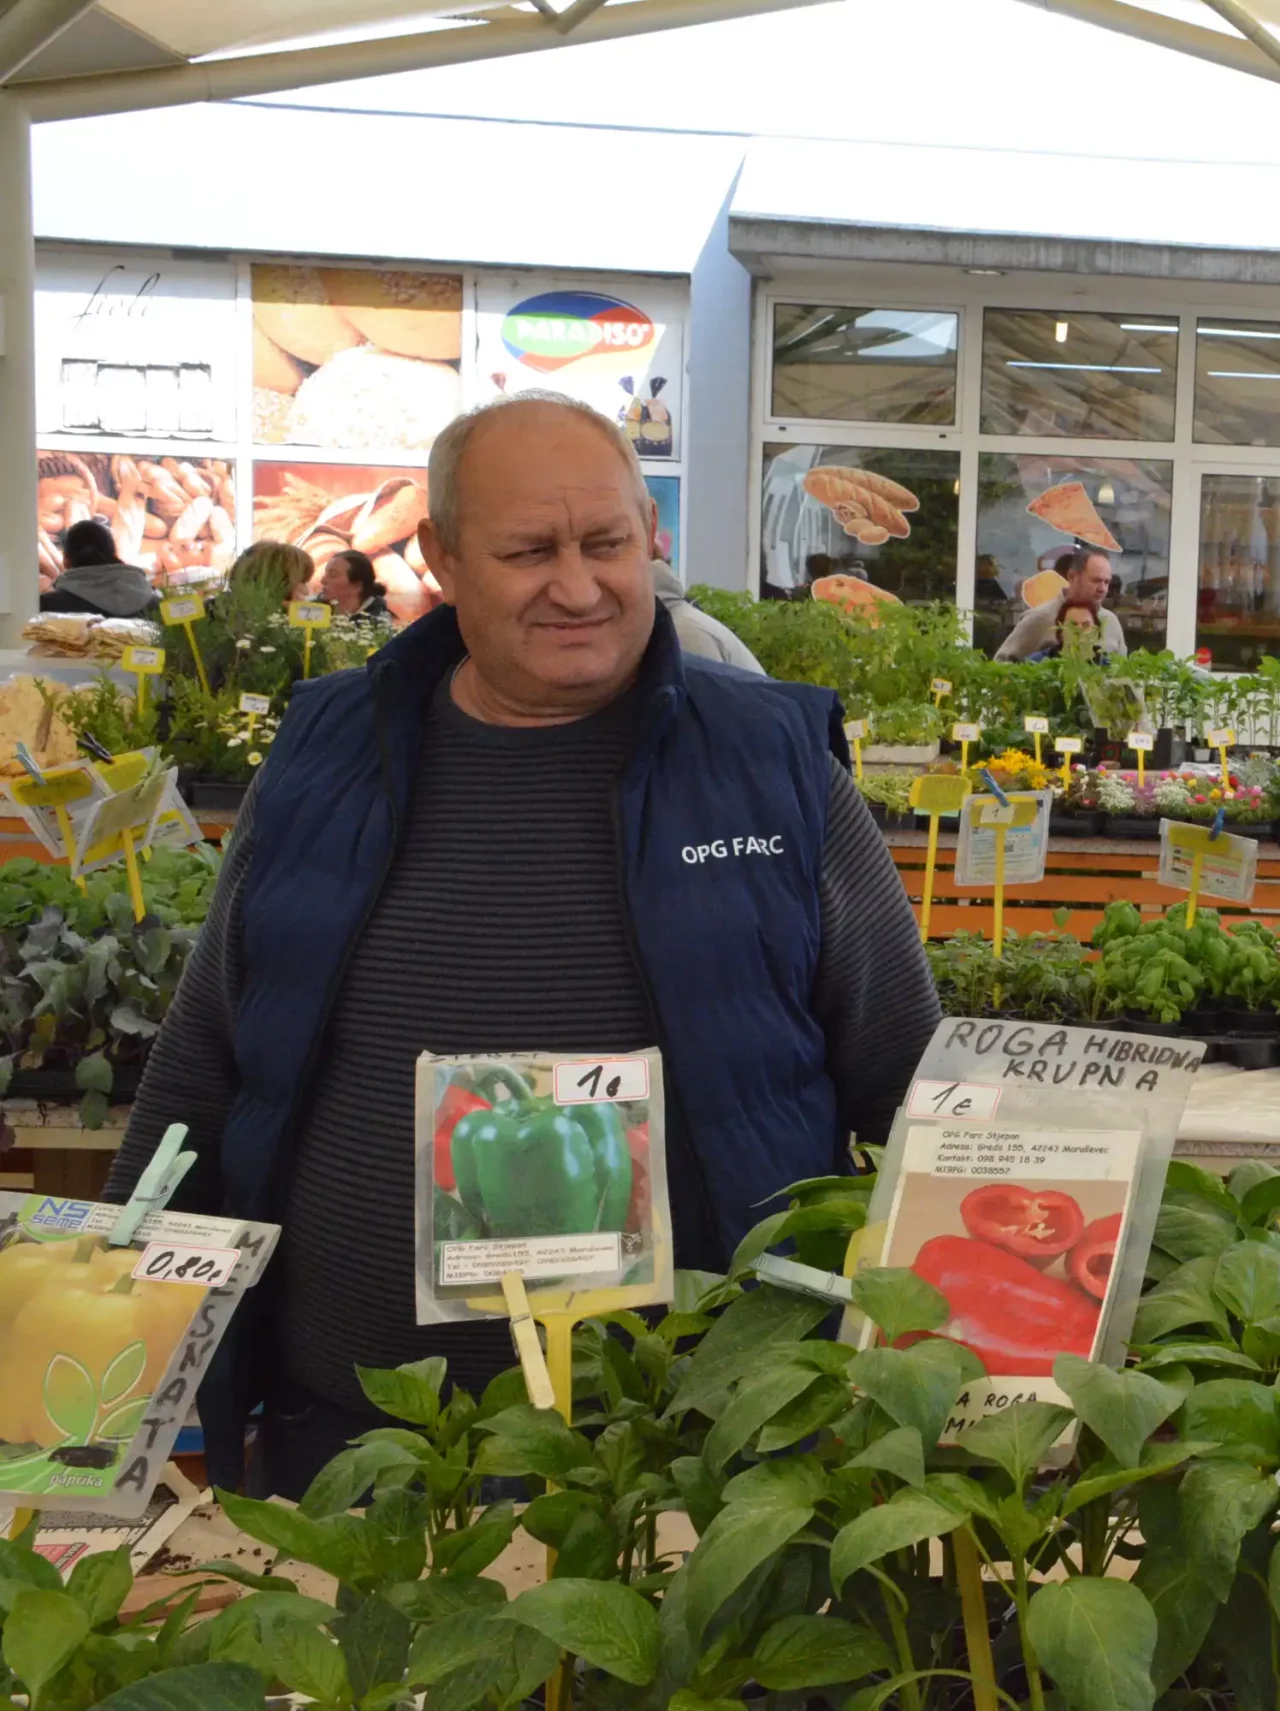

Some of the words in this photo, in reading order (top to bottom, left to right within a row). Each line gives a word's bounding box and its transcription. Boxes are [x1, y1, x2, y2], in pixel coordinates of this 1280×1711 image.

[516, 319, 647, 346] PARADISO
[681, 839, 728, 864] OPG
[732, 835, 784, 857] FARC
[944, 1021, 1069, 1058] ROGA
[1083, 1035, 1202, 1074] HIBRIDNA
[942, 1130, 961, 1139] OPG
[963, 1131, 983, 1140] Farc
[986, 1131, 1020, 1142] Stjepan
[940, 1142, 974, 1151] Adresa:
[1030, 1144, 1059, 1153] 42243
[937, 1153, 973, 1162] Kontakt:
[977, 1154, 995, 1163] 098
[1019, 1155, 1030, 1164] 18
[1033, 1155, 1046, 1164] 39
[38, 1197, 93, 1218] NS
[31, 1214, 84, 1229] seme
[50, 1473, 104, 1488] paprika
